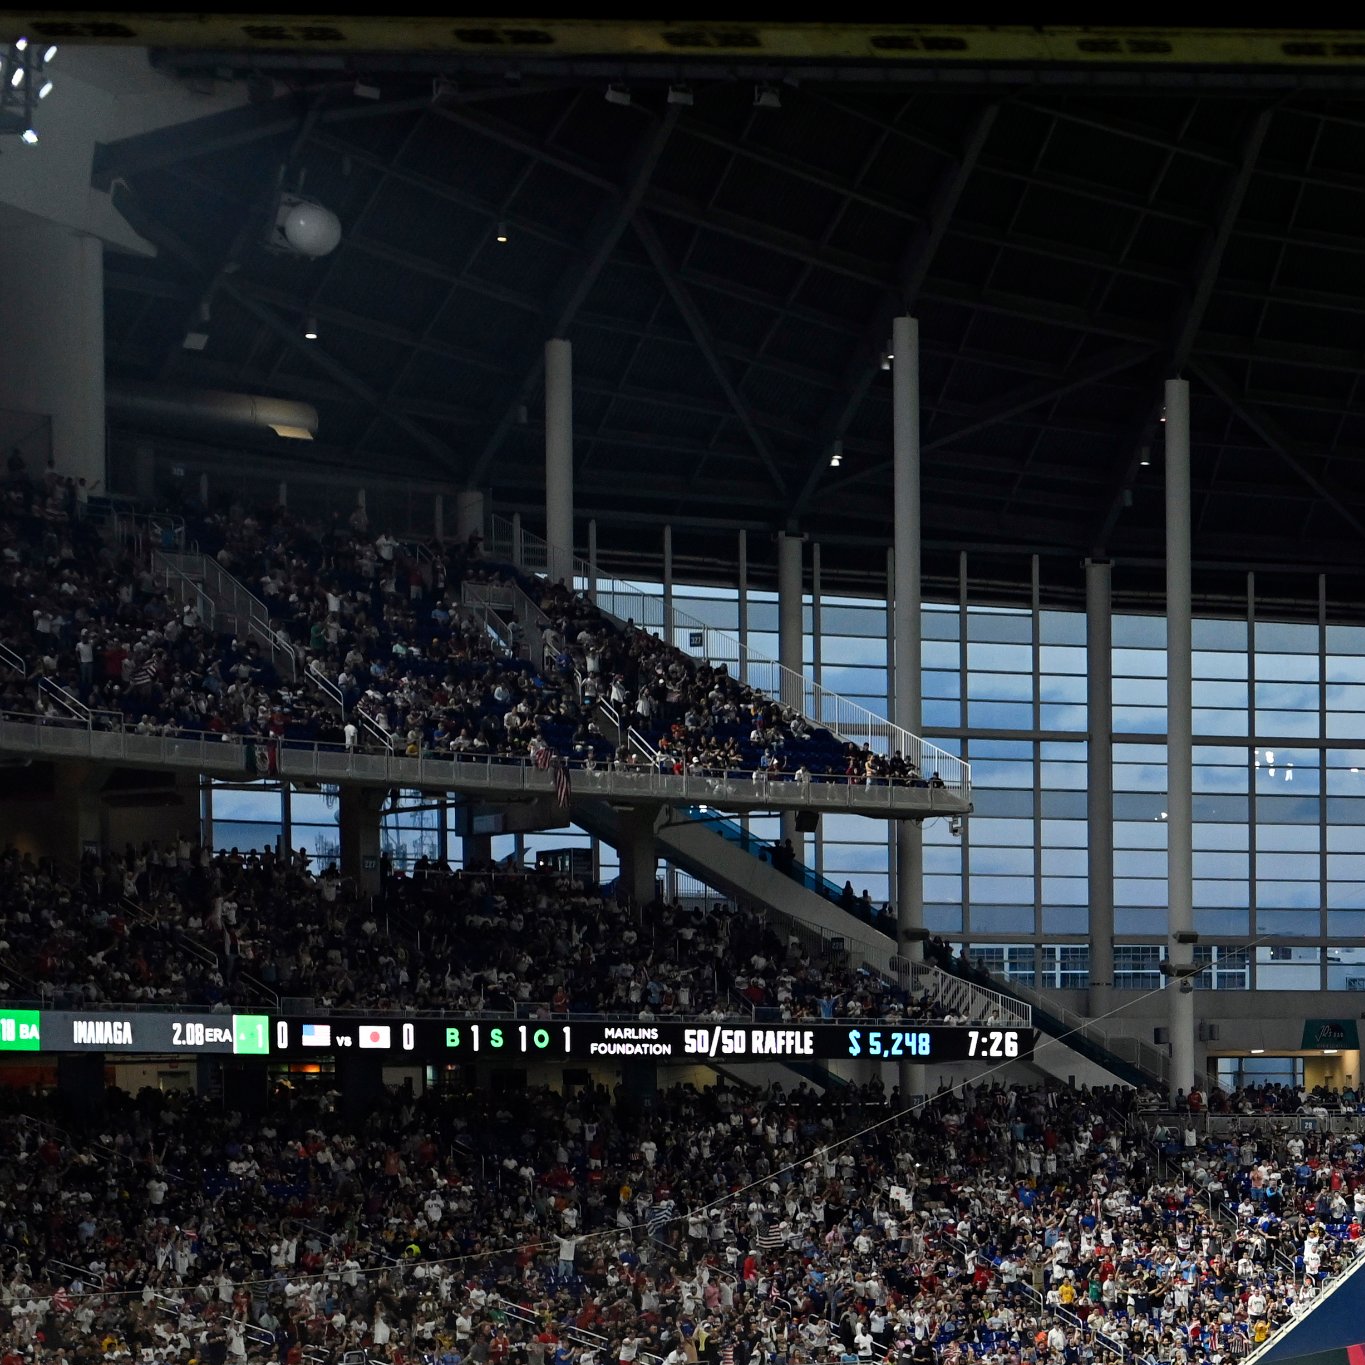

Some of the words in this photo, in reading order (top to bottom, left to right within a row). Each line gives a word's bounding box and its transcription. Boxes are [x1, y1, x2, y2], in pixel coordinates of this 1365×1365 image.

[20, 1024, 40, 1040] BA
[73, 1020, 133, 1045] IMANAGA
[173, 1022, 205, 1046] 2.08
[206, 1028, 232, 1043] ERA
[277, 1023, 288, 1049] 0
[403, 1023, 414, 1050] 0
[446, 1028, 459, 1047] B
[471, 1024, 480, 1051] 1
[490, 1028, 504, 1048] S
[520, 1025, 527, 1052] 1
[563, 1026, 571, 1052] 1
[604, 1028, 659, 1039] MARLINS
[684, 1029, 746, 1056] 50/50
[752, 1030, 814, 1055] RAFFLE
[849, 1029, 860, 1057] $
[870, 1031, 930, 1057] 5,248
[968, 1031, 1019, 1057] 7:26
[590, 1043, 671, 1055] FOUNDATION
